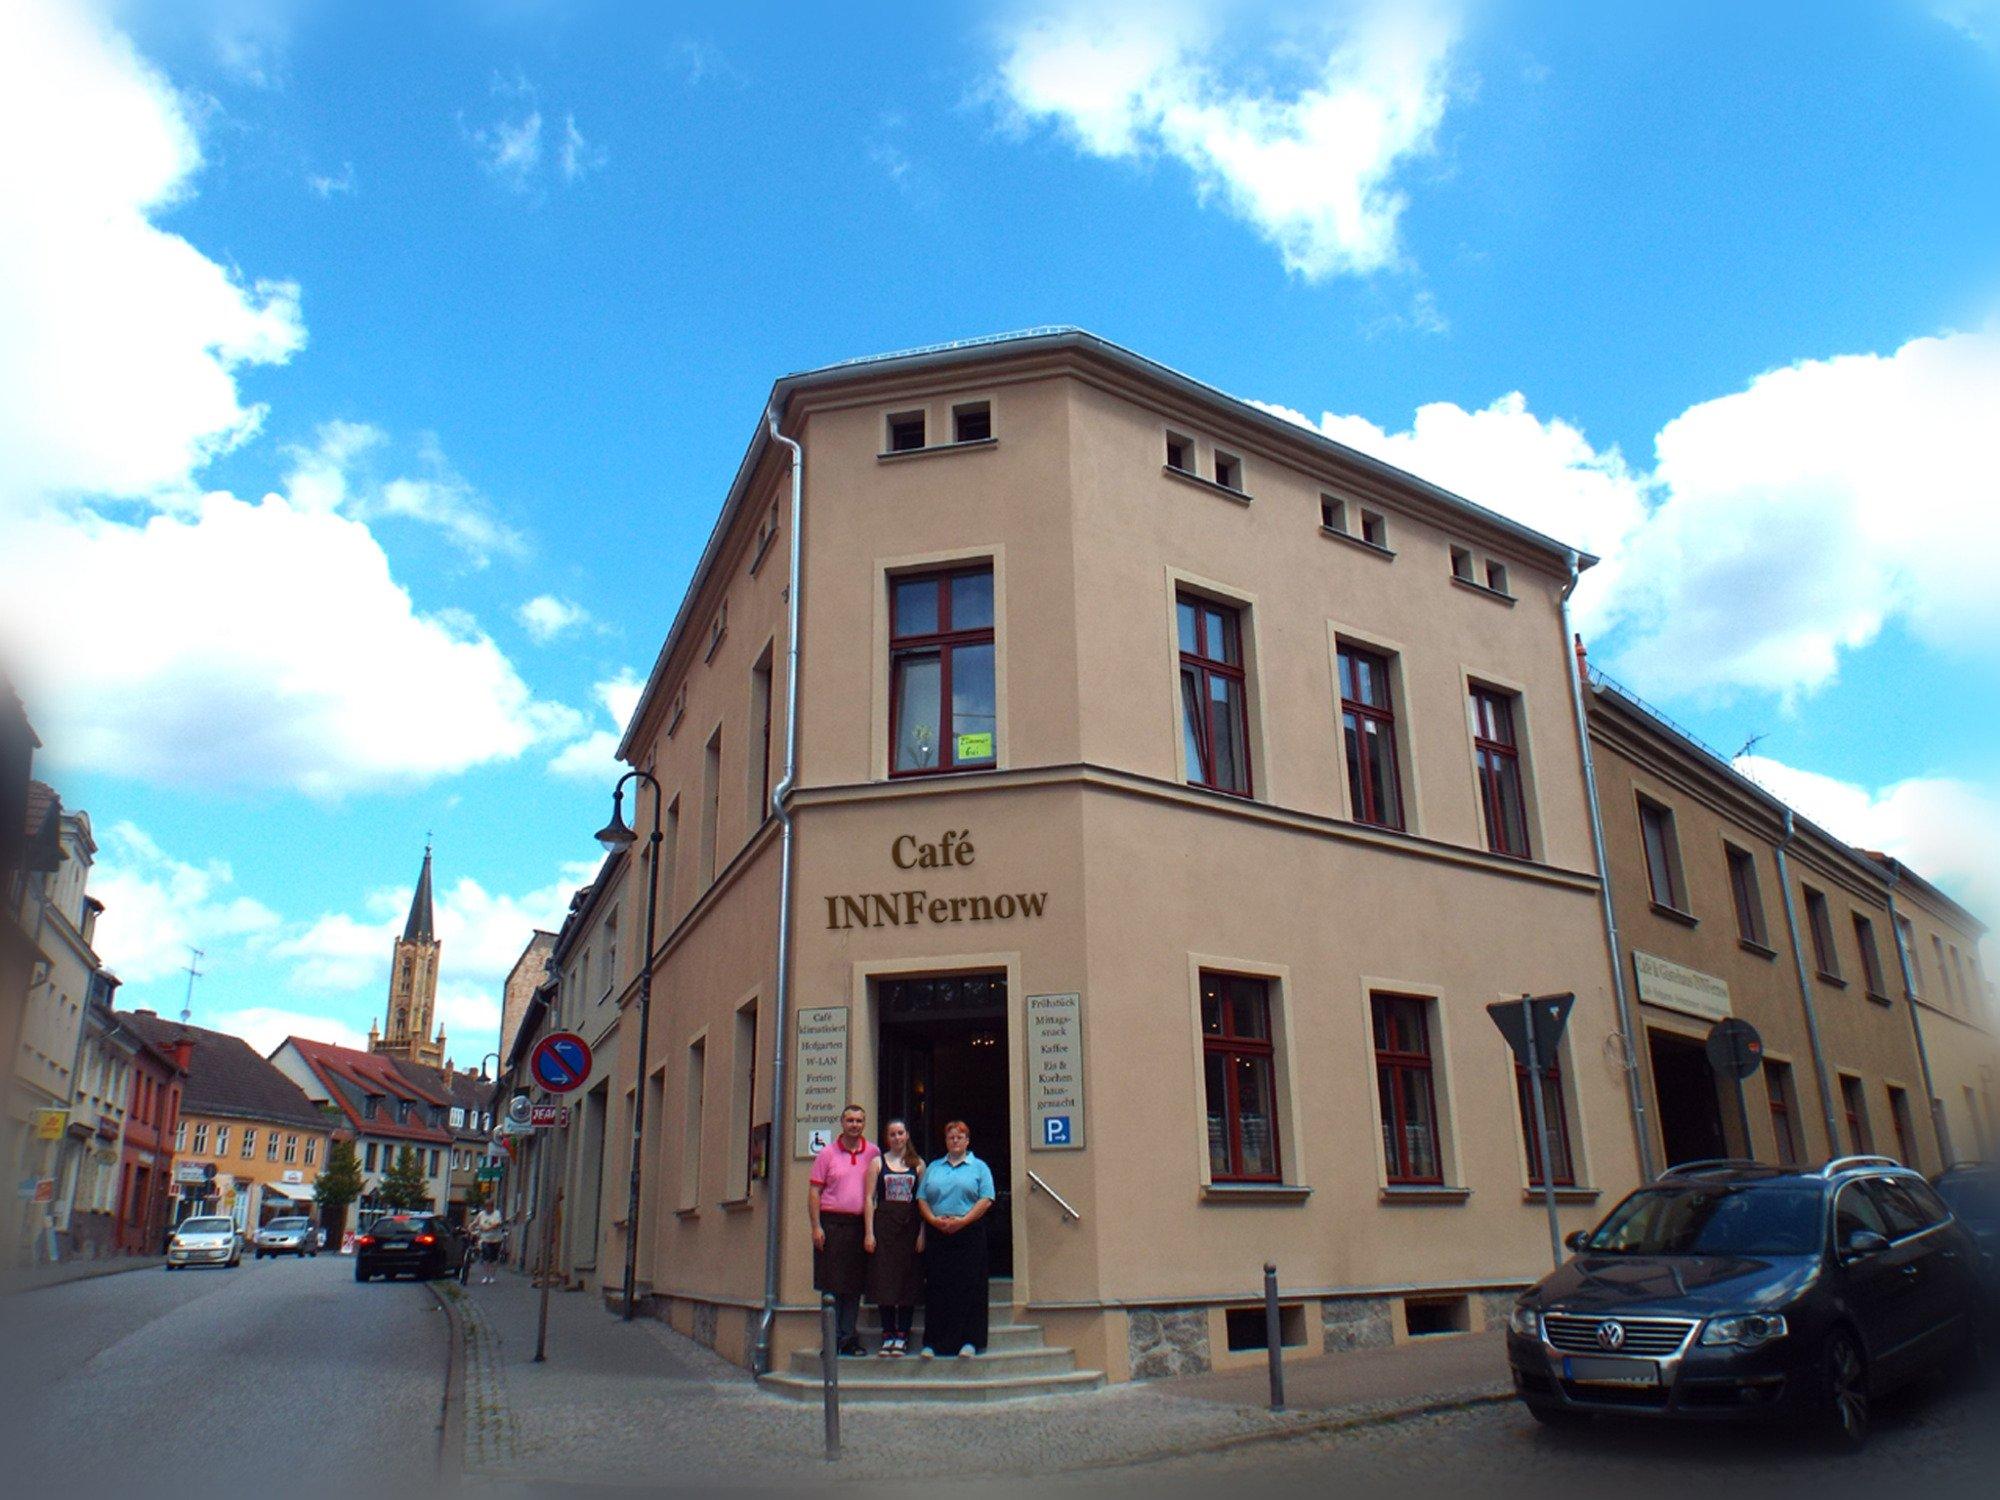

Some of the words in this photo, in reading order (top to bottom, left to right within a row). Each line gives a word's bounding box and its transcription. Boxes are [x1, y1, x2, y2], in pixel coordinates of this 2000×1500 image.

[891, 828, 976, 870] Café
[823, 889, 1049, 931] INNFernow
[1031, 997, 1075, 1009] Frühstück
[812, 1011, 832, 1022] Café
[801, 1041, 843, 1051] Hofgarten
[1041, 1043, 1069, 1054] Kaffee
[1039, 1073, 1073, 1083] Kuchen
[1048, 1119, 1063, 1142] P
